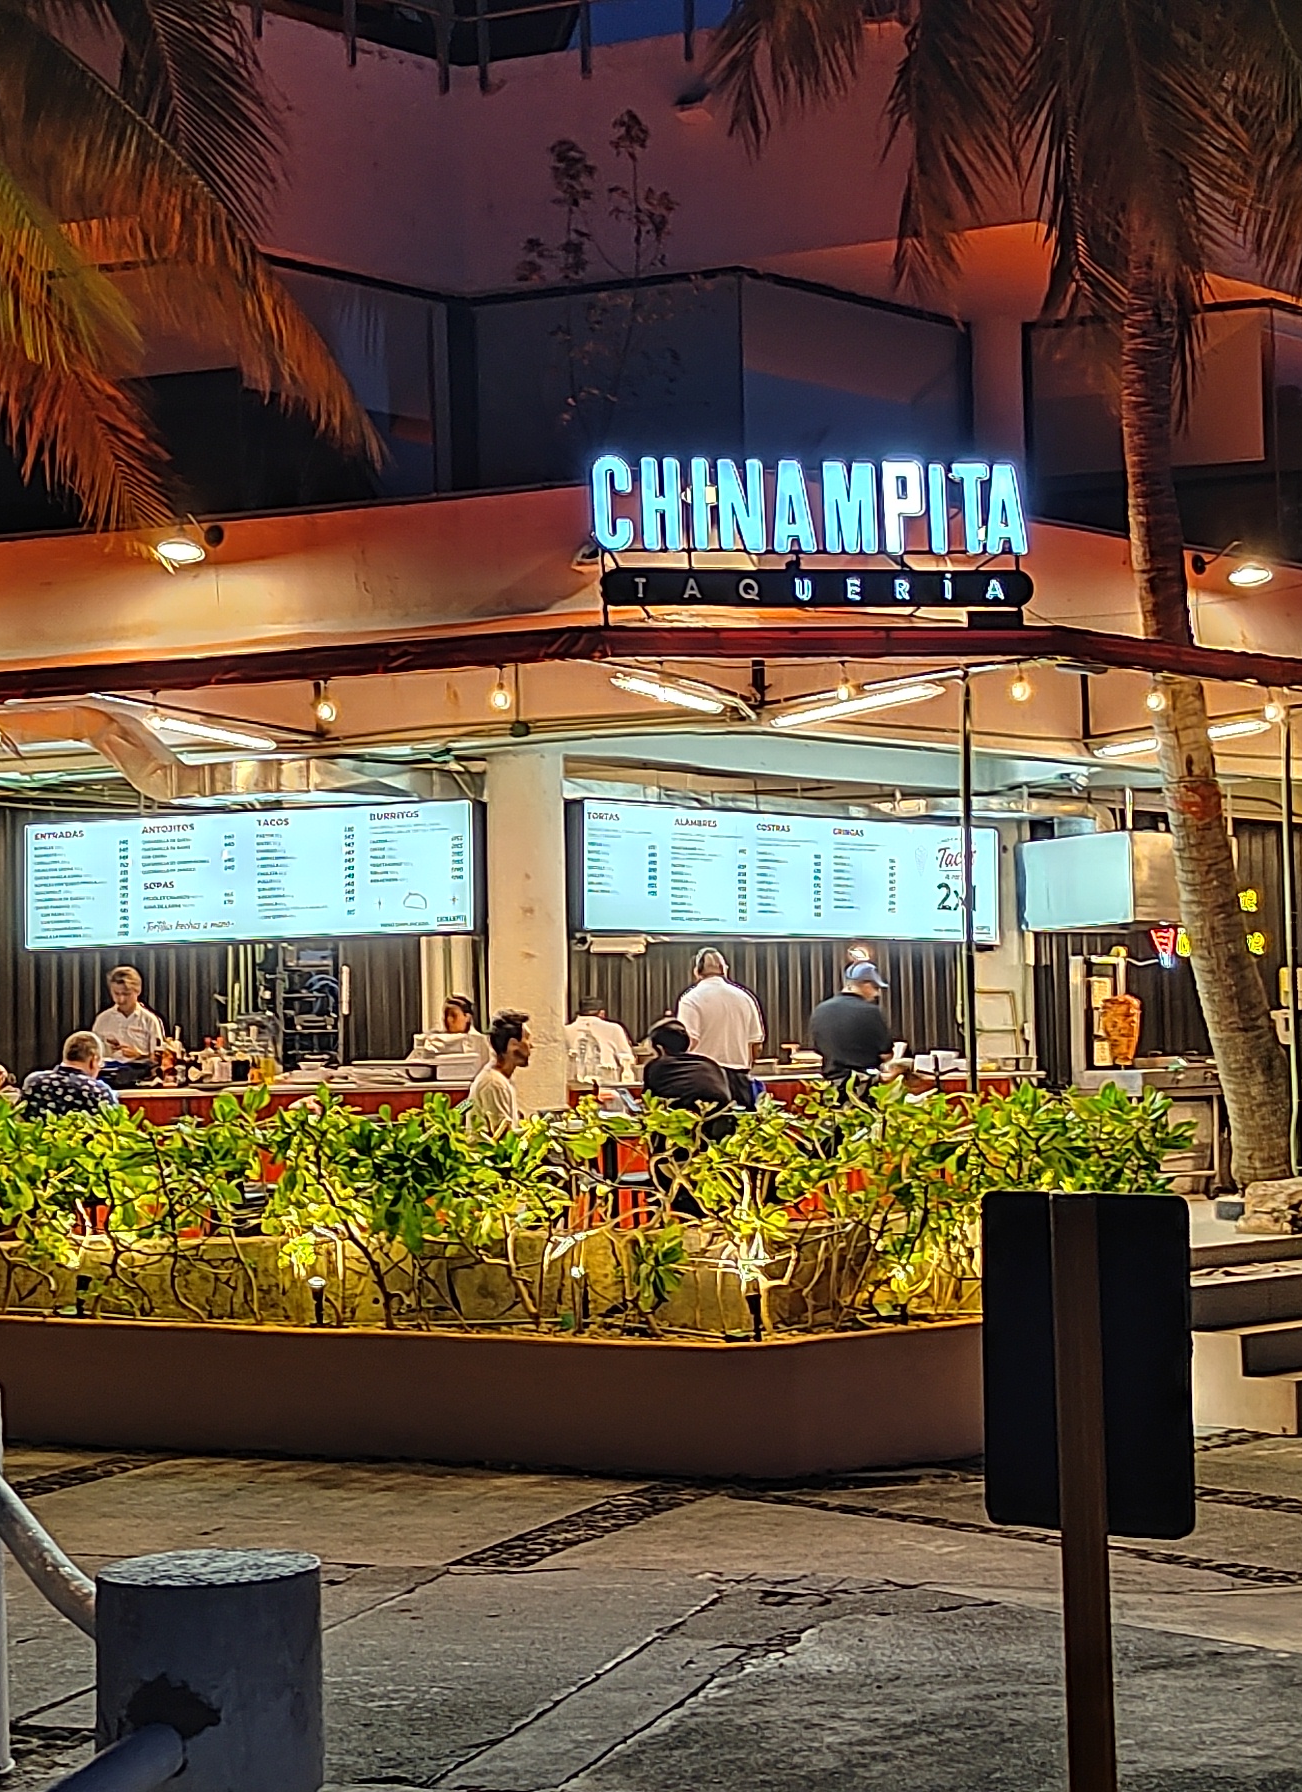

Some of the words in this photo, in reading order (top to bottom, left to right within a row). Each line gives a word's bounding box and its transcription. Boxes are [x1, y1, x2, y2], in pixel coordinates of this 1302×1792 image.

[592, 454, 1028, 555] CHINAMPITA
[587, 811, 620, 821] TORTAS
[256, 818, 289, 826] TACOS
[141, 823, 195, 834] ANTOJITOS
[756, 823, 790, 832] COSTRAS
[34, 830, 84, 840] ENTRADAS
[143, 881, 174, 890] SOPAS
